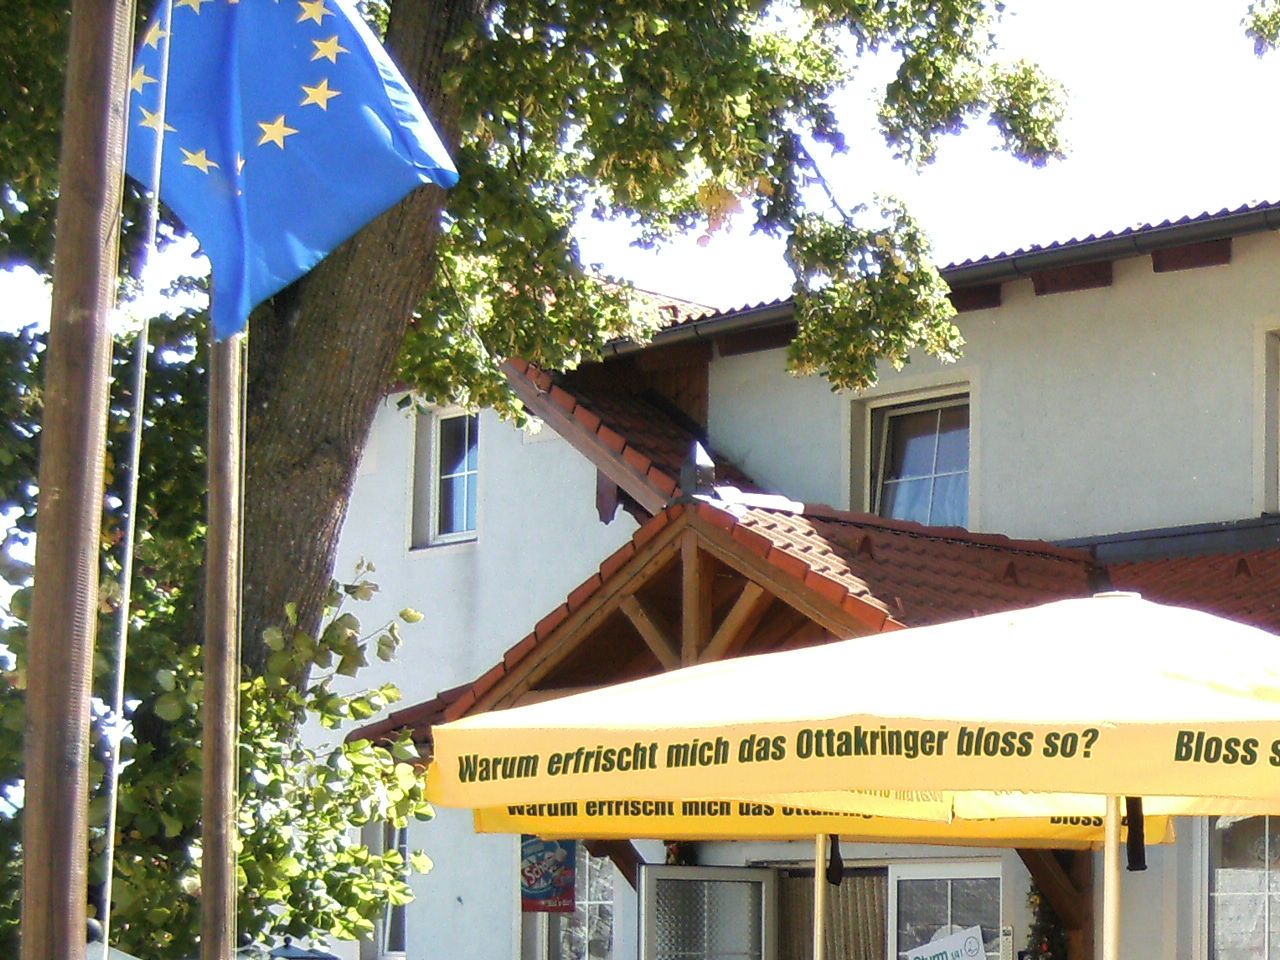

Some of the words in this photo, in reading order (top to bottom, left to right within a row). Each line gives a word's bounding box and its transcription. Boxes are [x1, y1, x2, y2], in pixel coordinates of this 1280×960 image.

[458, 753, 540, 782] Warum
[547, 742, 658, 776] erfrischt
[666, 736, 730, 768] mich
[738, 734, 786, 763] das
[797, 725, 949, 759] Ottakringer
[957, 727, 1034, 758] bloss
[1042, 728, 1099, 758] so?
[1174, 731, 1259, 765] Bloss
